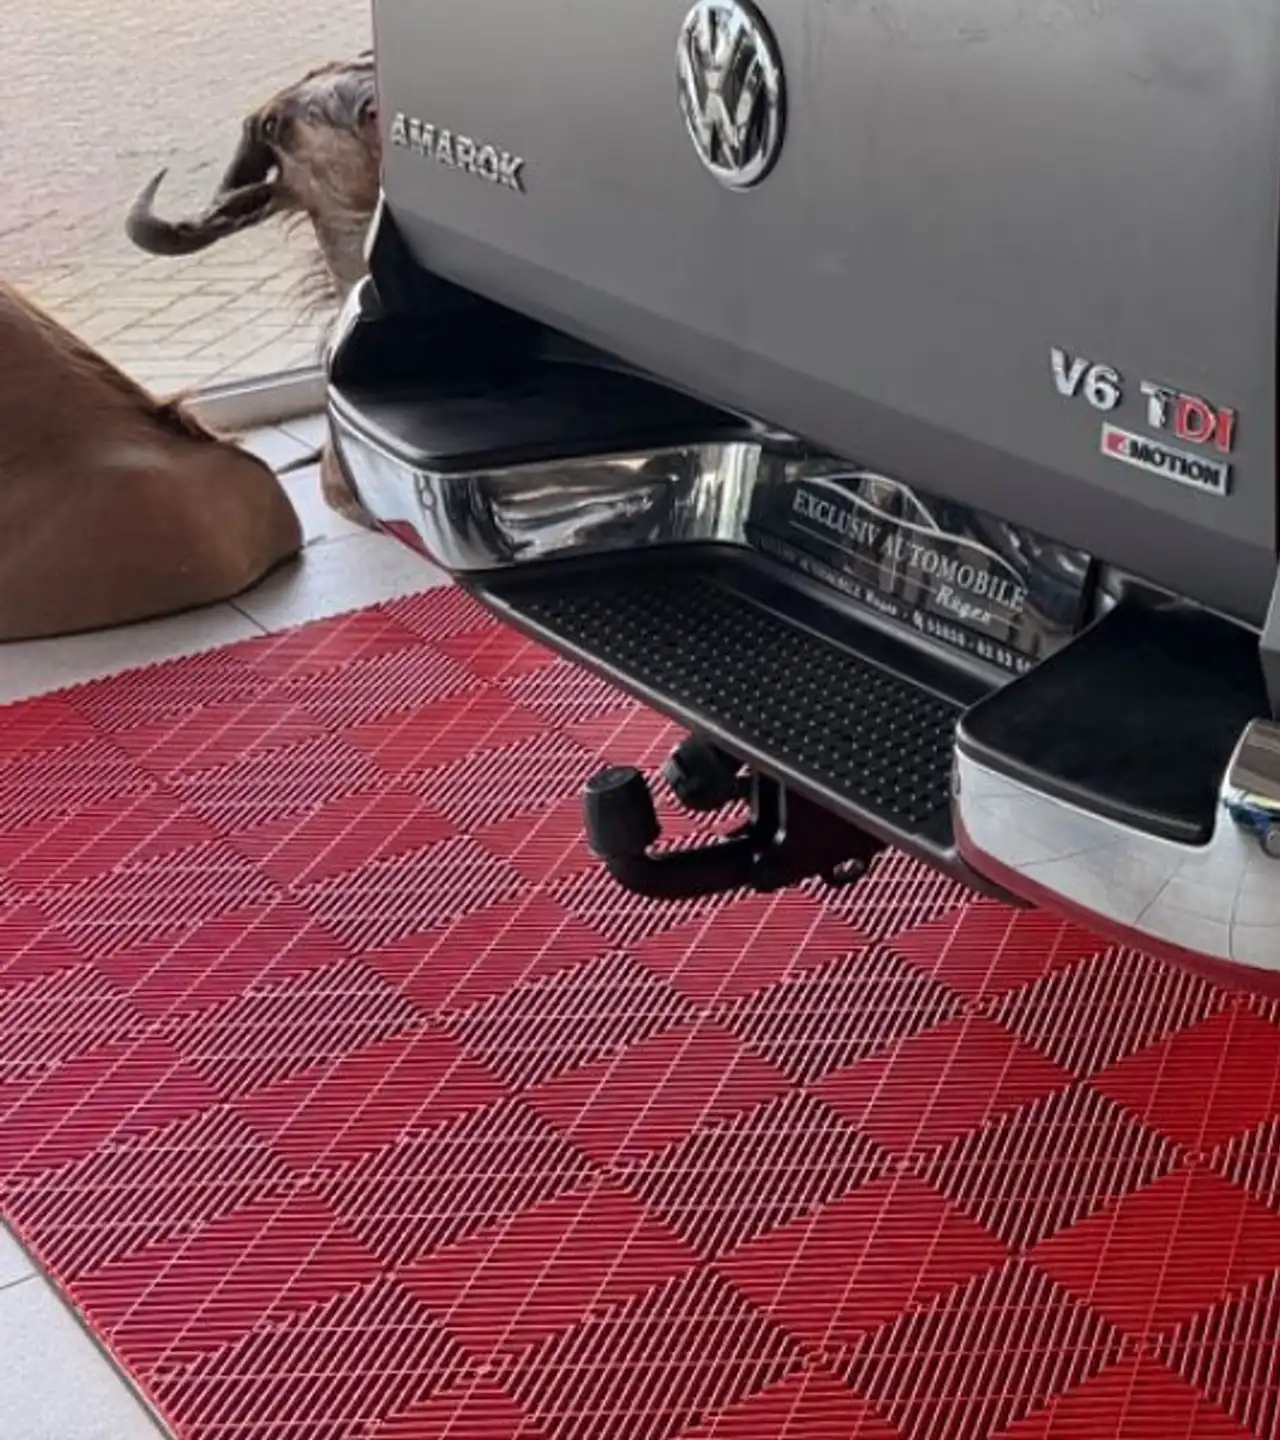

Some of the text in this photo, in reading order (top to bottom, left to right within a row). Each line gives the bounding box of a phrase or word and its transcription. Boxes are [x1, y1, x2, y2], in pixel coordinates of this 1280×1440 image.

[390, 111, 525, 192] AMAROK
[1050, 346, 1236, 454] V6 TDI
[792, 489, 880, 549] EXCLUSIV
[882, 531, 1029, 613] AUTOMOBILE
